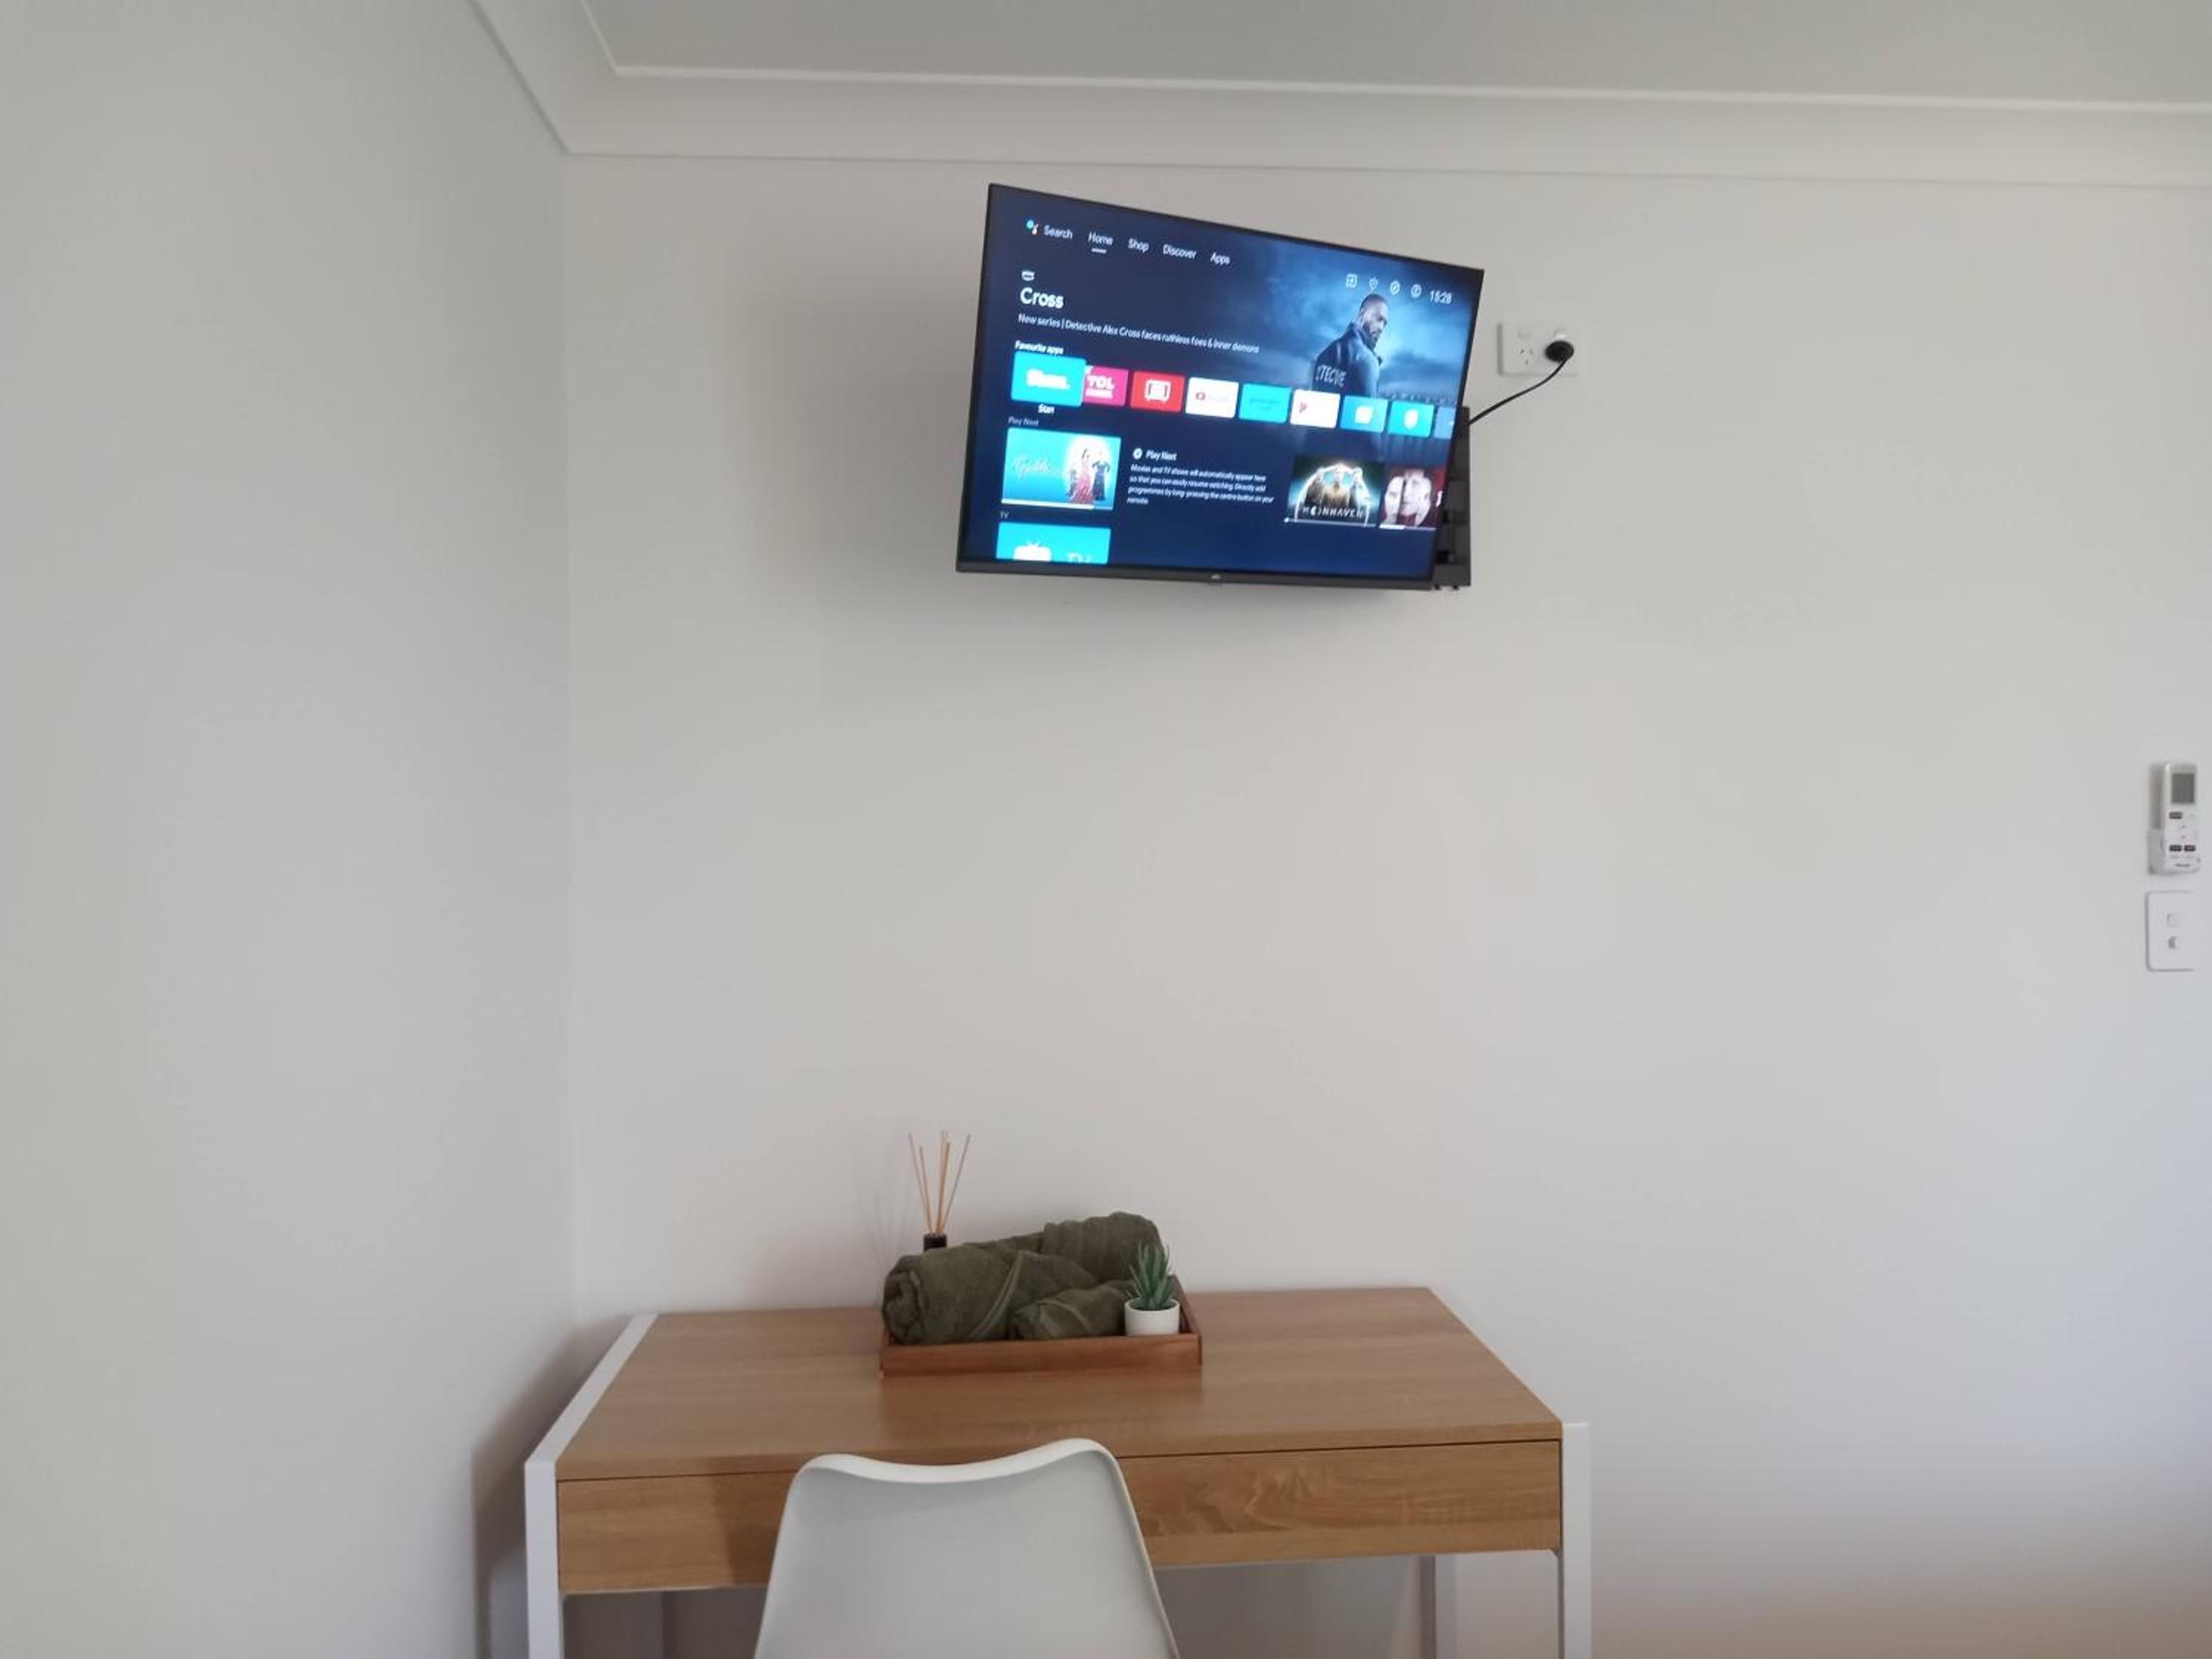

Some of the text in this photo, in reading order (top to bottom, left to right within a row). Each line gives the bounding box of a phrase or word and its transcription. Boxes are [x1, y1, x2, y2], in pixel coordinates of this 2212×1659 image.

[1043, 224, 1074, 240] Search
[1088, 231, 1114, 246] Home
[1128, 237, 1150, 253] Shop
[1163, 243, 1197, 259] Discover
[1210, 251, 1231, 265] Apps
[1020, 286, 1064, 309] Cross
[1018, 313, 1036, 324] New
[1037, 316, 1060, 328] series
[1065, 319, 1102, 333] Detective
[1102, 324, 1119, 335] Alex
[1119, 327, 1141, 338] Cross
[1141, 330, 1161, 341] faces
[1015, 340, 1046, 352] Favourite
[1146, 450, 1161, 462] Play
